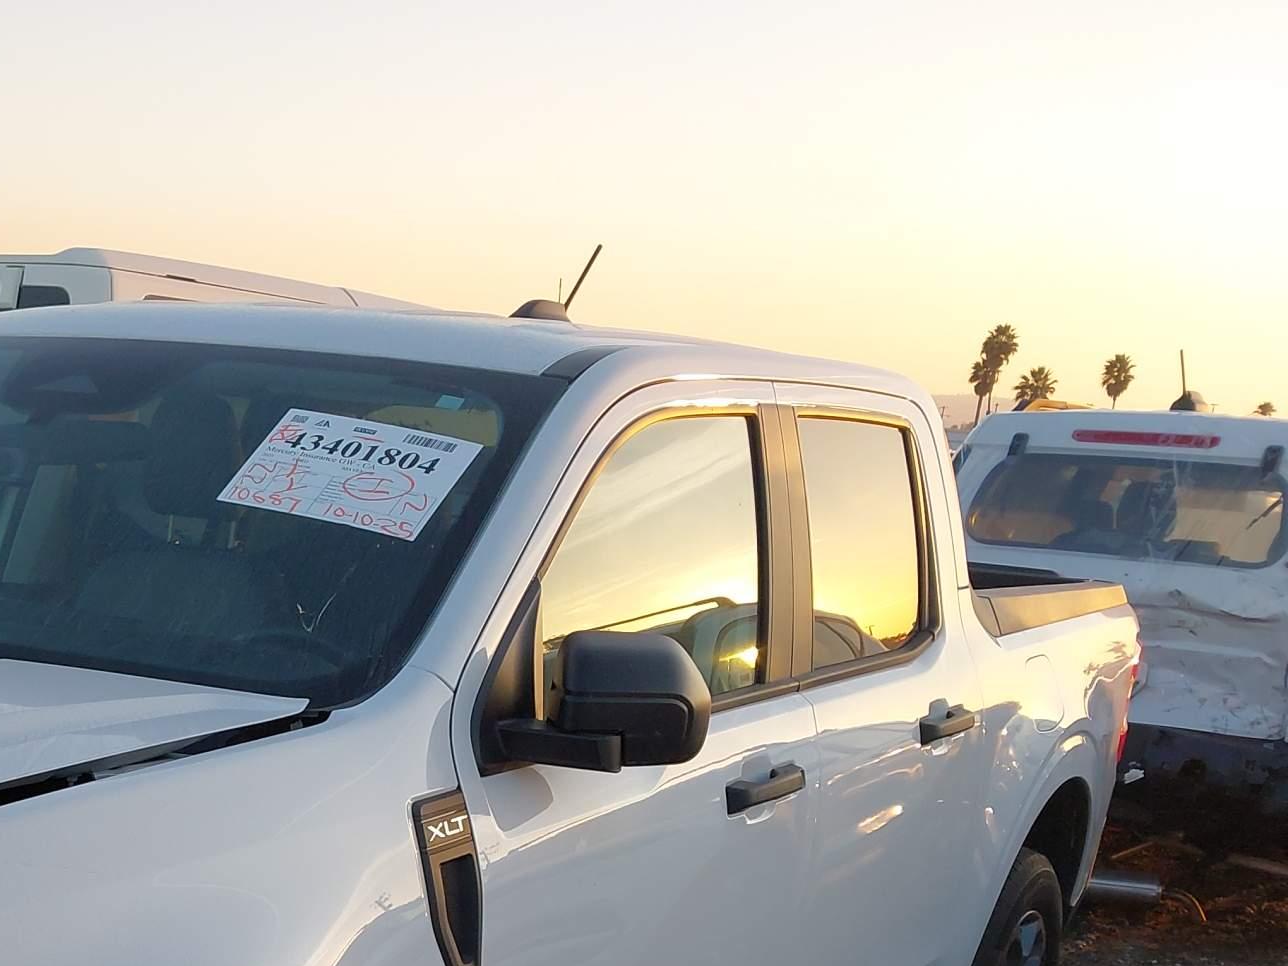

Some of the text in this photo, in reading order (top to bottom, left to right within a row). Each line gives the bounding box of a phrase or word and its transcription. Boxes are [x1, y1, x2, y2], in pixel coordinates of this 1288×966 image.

[285, 432, 442, 475] 43401804
[299, 451, 338, 464] Insurance
[323, 502, 415, 539] 10-10-25
[427, 815, 468, 841] XLT
